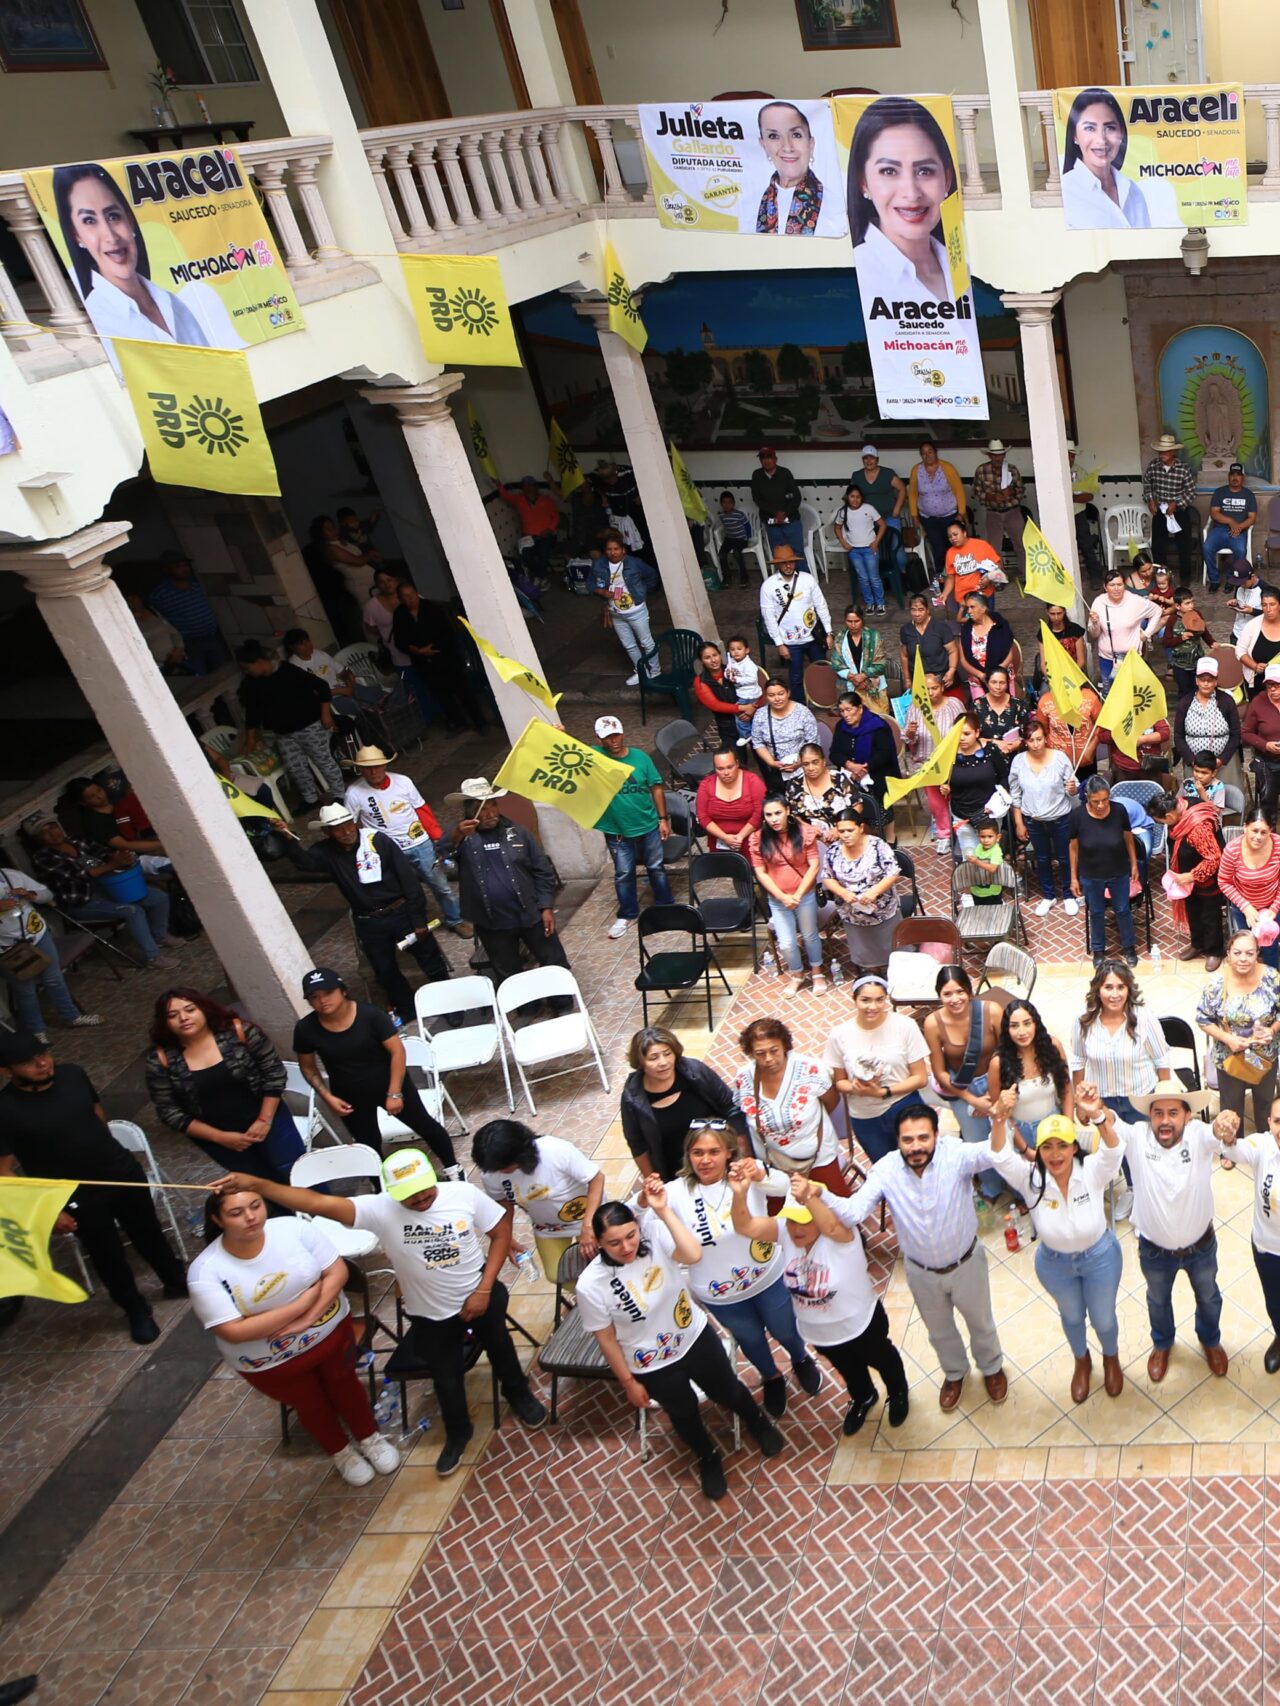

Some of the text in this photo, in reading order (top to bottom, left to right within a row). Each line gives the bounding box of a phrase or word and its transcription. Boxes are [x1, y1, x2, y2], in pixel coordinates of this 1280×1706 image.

[1129, 91, 1238, 123] Araceli
[657, 105, 744, 140] Julieta
[1157, 129, 1201, 138] SAUCEDO
[672, 139, 735, 155] Gallardo
[125, 149, 243, 207] Araceli
[672, 157, 743, 169] DIPUTADA LOCAL
[1140, 160, 1222, 177] MICHOACN
[169, 200, 253, 224] SAUCEDO SENADORA
[169, 247, 257, 285] MICHOACN
[608, 271, 626, 307] PRD
[426, 285, 454, 332] PRD
[869, 294, 972, 320] Araceli
[899, 320, 944, 329] Saucedo
[884, 339, 953, 351] Michoacán
[147, 390, 186, 449] PRD
[528, 767, 578, 795] PRD
[368, 796, 388, 828] Julieta
[691, 1197, 717, 1247] Julieta
[424, 1251, 460, 1263] TODO
[609, 1277, 646, 1323] Julieta
